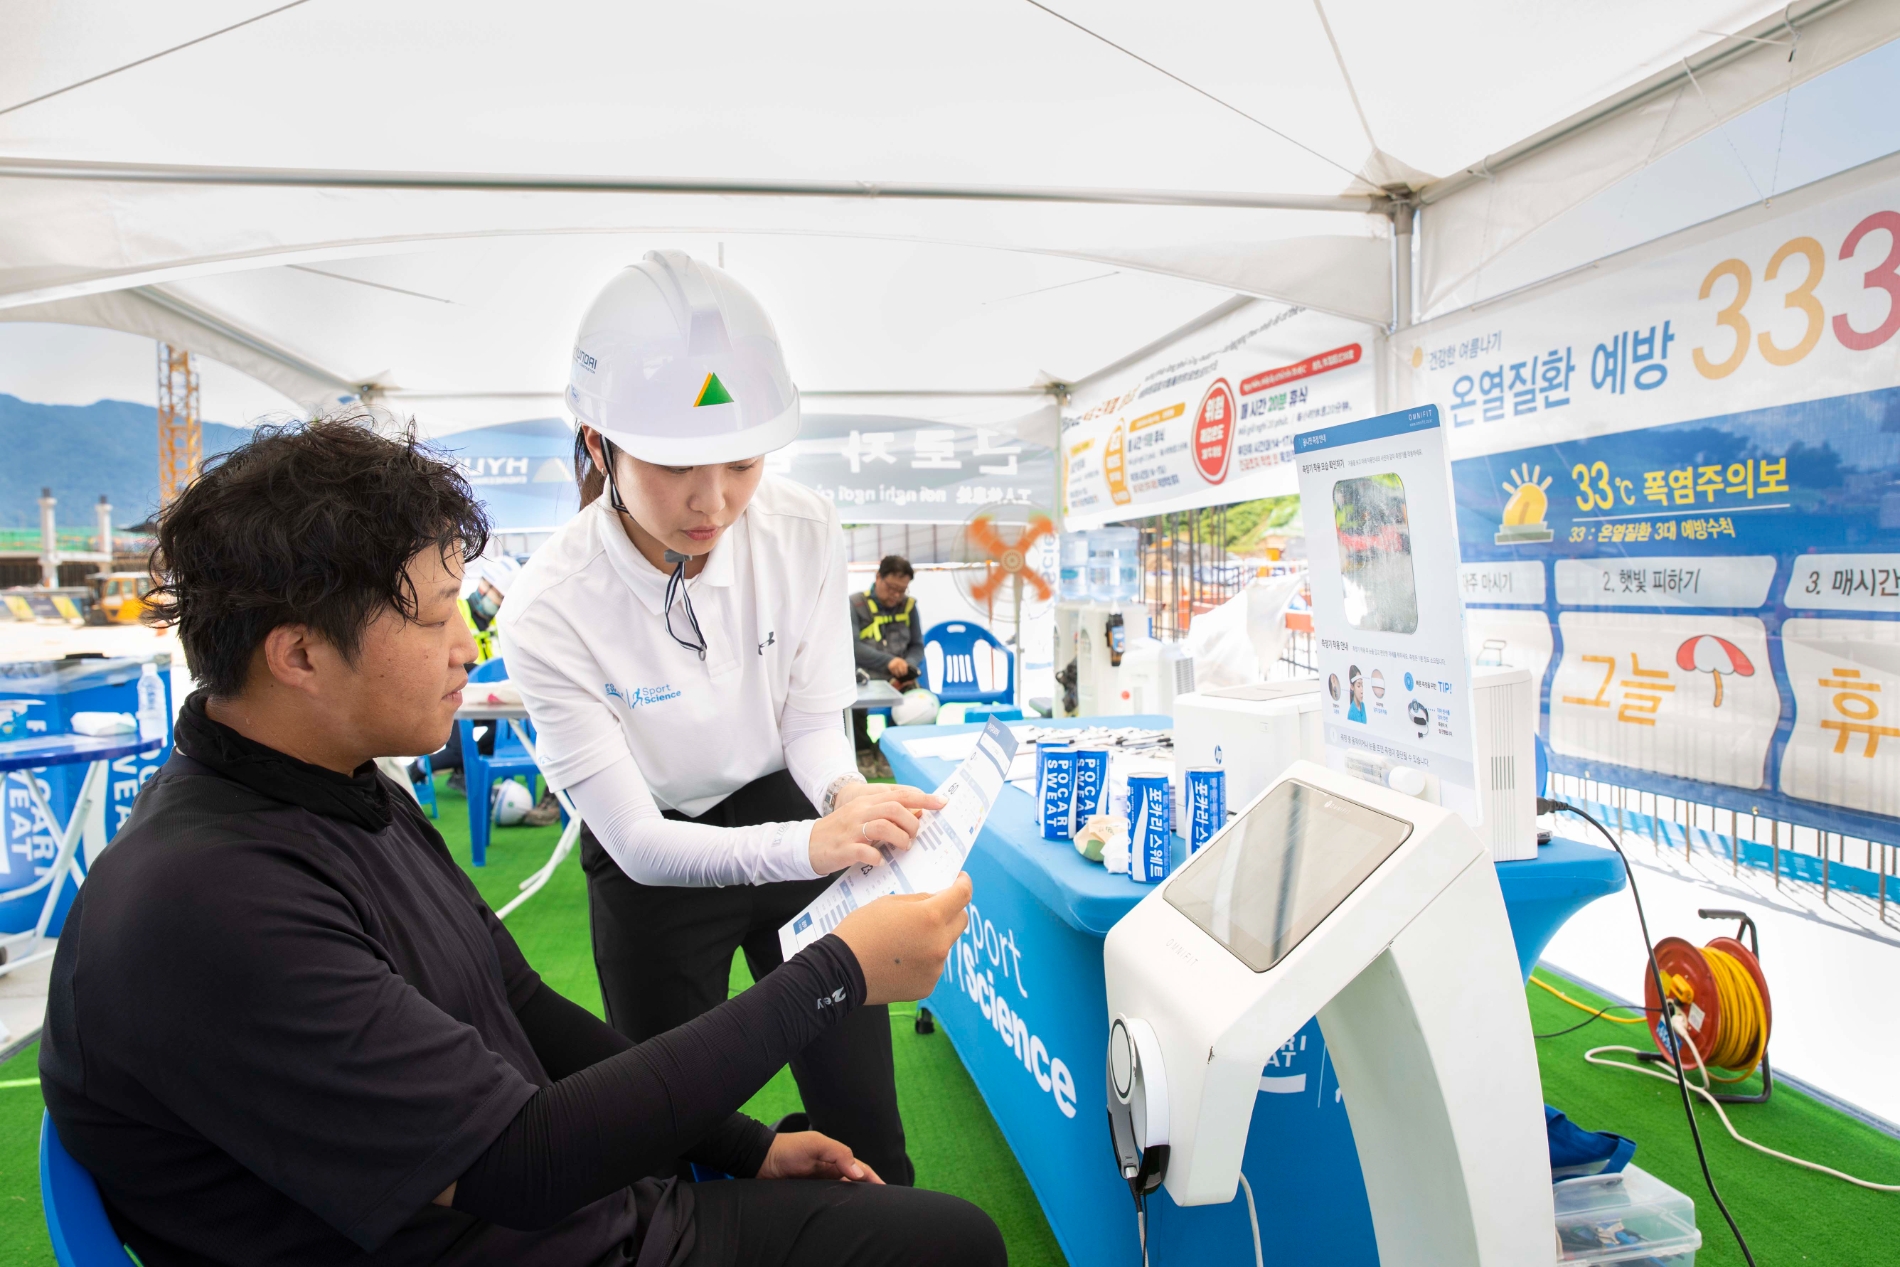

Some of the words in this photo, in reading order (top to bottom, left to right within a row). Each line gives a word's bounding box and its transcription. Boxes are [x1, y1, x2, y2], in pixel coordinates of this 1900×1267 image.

[1692, 210, 1900, 380] 333
[1429, 345, 1456, 371] 건강한
[1458, 330, 1502, 365] 여름나기
[1450, 347, 1575, 428] 온열질환
[1591, 320, 1675, 396] 예방
[1409, 409, 1432, 421] OMNIFIT
[1643, 457, 1790, 507] 폭염주의보
[1568, 527, 1586, 543] 33
[1598, 520, 1652, 542] 온열질환
[1654, 520, 1677, 541] 3대
[1681, 517, 1736, 540] 예방수칙
[1481, 571, 1514, 593] 마시기
[1603, 571, 1616, 592] 2.
[1619, 569, 1647, 594] 햇빛
[1652, 568, 1701, 594] 피하기
[1805, 571, 1821, 595] 3.
[1832, 568, 1900, 596] 매시간
[643, 684, 671, 697] Sport
[644, 690, 681, 704] Science
[1438, 681, 1452, 694] TIP!
[1562, 653, 1676, 727] 그늘
[1818, 668, 1900, 758] 휴
[1047, 760, 1058, 827] SWEAT
[1057, 760, 1069, 836] POCARI
[1084, 758, 1096, 824] POCA
[1149, 787, 1163, 831] 포카리
[1195, 781, 1209, 824] 포카리
[1149, 834, 1163, 877] 스웨트
[963, 904, 1028, 998] port
[1165, 938, 1199, 967] OMNIFIT
[963, 943, 1077, 1118] Science
